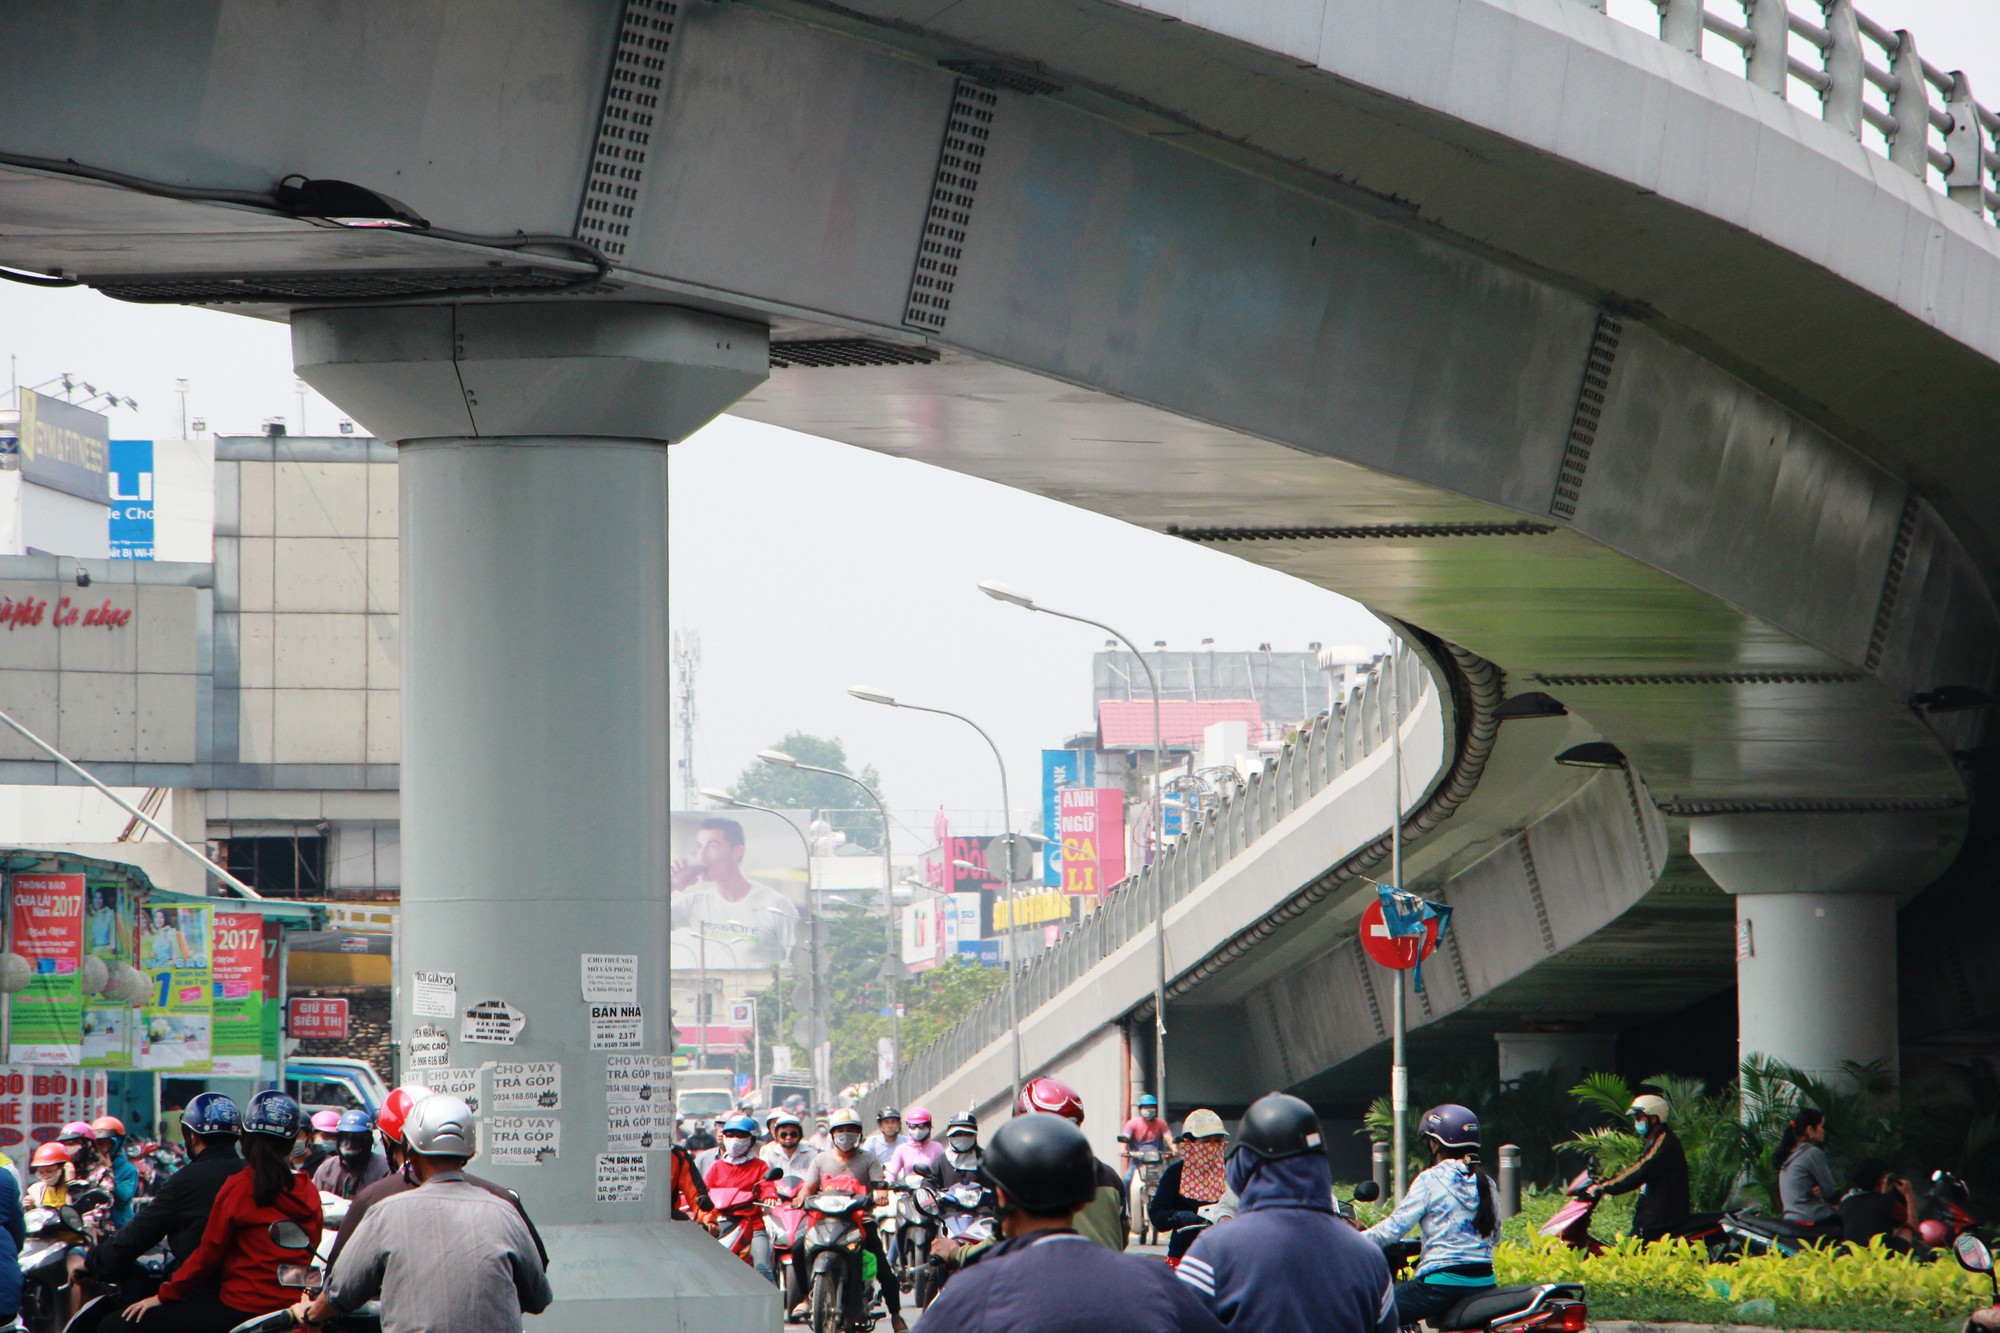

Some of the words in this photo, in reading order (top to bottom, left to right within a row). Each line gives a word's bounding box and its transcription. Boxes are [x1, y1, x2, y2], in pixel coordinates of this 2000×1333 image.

[1063, 790, 1095, 808] ANH
[1062, 812, 1095, 832] NGỮ
[1063, 838, 1097, 862] CA
[1067, 867, 1094, 891] LI
[52, 895, 81, 917] 2017
[218, 928, 260, 950] 2017
[155, 972, 173, 1007] 1
[300, 1002, 320, 1013] GIỮ
[324, 1003, 338, 1013] XE
[592, 1005, 617, 1018] BÁN
[620, 1003, 642, 1018] NHÀ
[294, 1014, 320, 1026] SIÊU
[323, 1016, 342, 1028] THỊ
[608, 1057, 631, 1066] CHO
[634, 1056, 651, 1065] VAY
[428, 1071, 449, 1081] CHO
[453, 1070, 476, 1079] VAY
[495, 1064, 524, 1075] CHO
[528, 1063, 556, 1073] VAY
[608, 1067, 629, 1079] TRẢ
[631, 1067, 651, 1079] GÓP
[32, 1070, 67, 1096] BÒ
[408, 1073, 420, 1081] VAY
[494, 1075, 521, 1088] TRẢ
[525, 1074, 555, 1086] GÓP
[429, 1081, 448, 1093] TRẢ
[451, 1081, 476, 1093] GÓP
[493, 1092, 538, 1101] 0934.168.604
[608, 1105, 632, 1115] CHO
[634, 1104, 651, 1114] VAY
[494, 1118, 523, 1128] CHO
[527, 1119, 555, 1128] VAY
[608, 1115, 630, 1128] TRẢ
[632, 1114, 651, 1127] GÓP
[493, 1129, 520, 1141] TRẢ
[524, 1129, 554, 1141] GÓP
[491, 1147, 536, 1155] 0934.168.604
